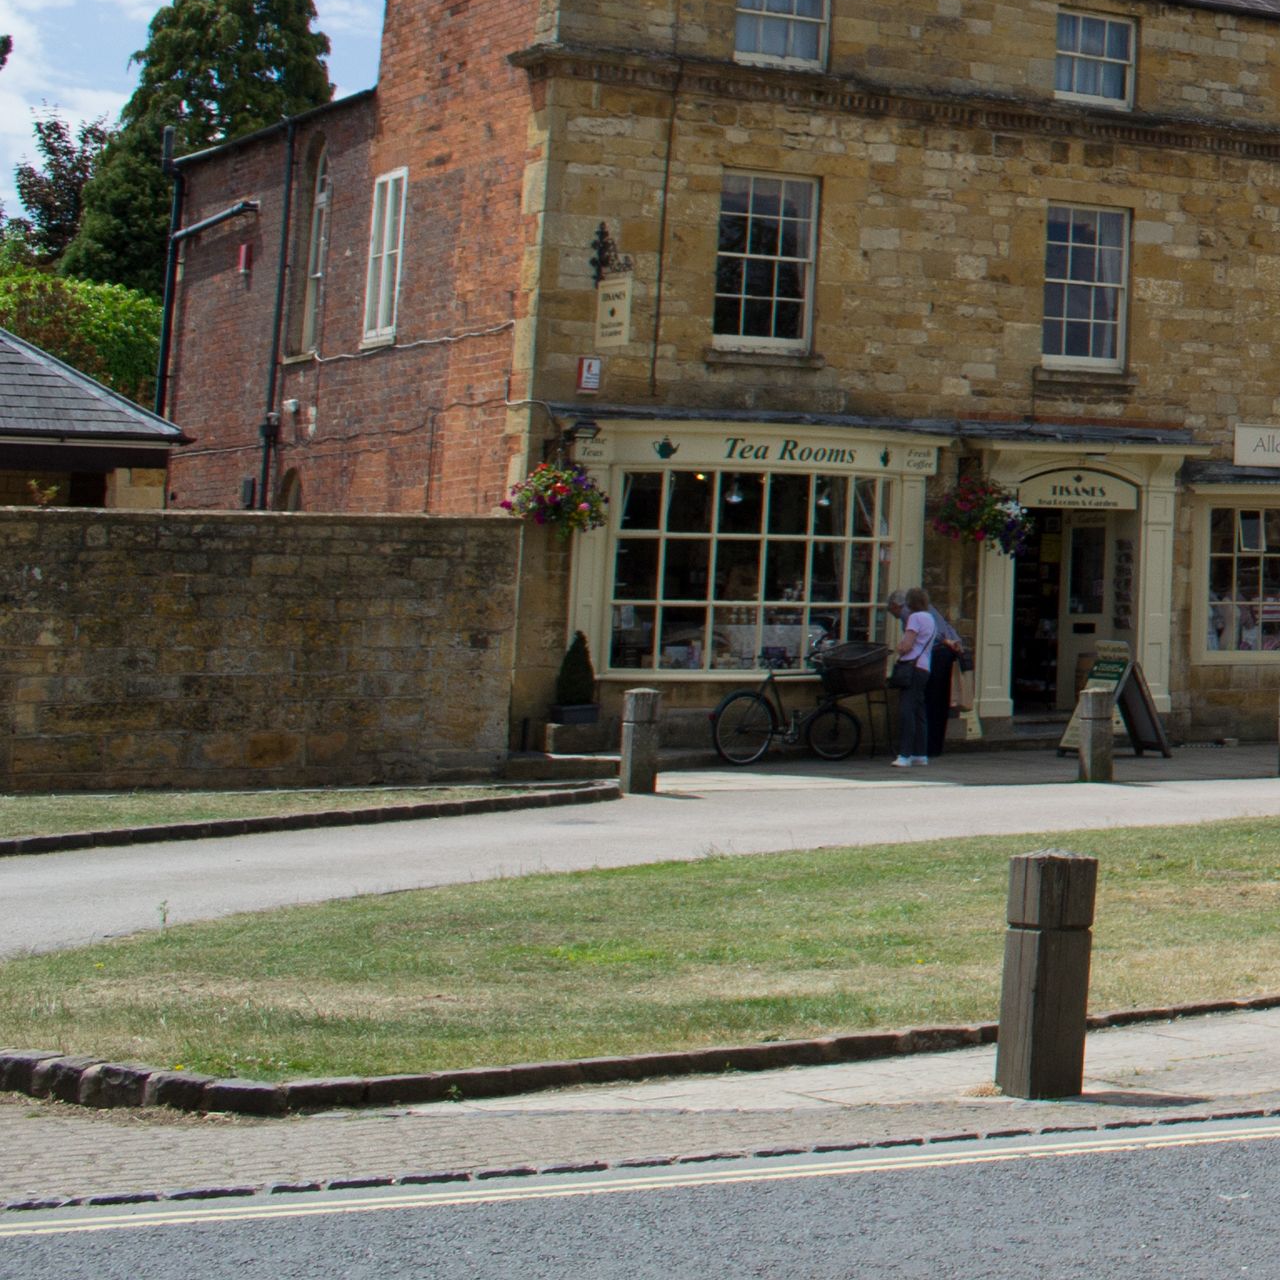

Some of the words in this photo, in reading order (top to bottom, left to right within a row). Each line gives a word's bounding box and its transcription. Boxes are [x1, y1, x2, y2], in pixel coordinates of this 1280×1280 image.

[582, 436, 607, 445] ine
[581, 446, 604, 458] Teas
[724, 437, 770, 461] Tea
[777, 439, 857, 464] Rooms
[907, 447, 932, 459] Fresh
[906, 458, 934, 470] Coffee
[1052, 485, 1106, 498] TISANES
